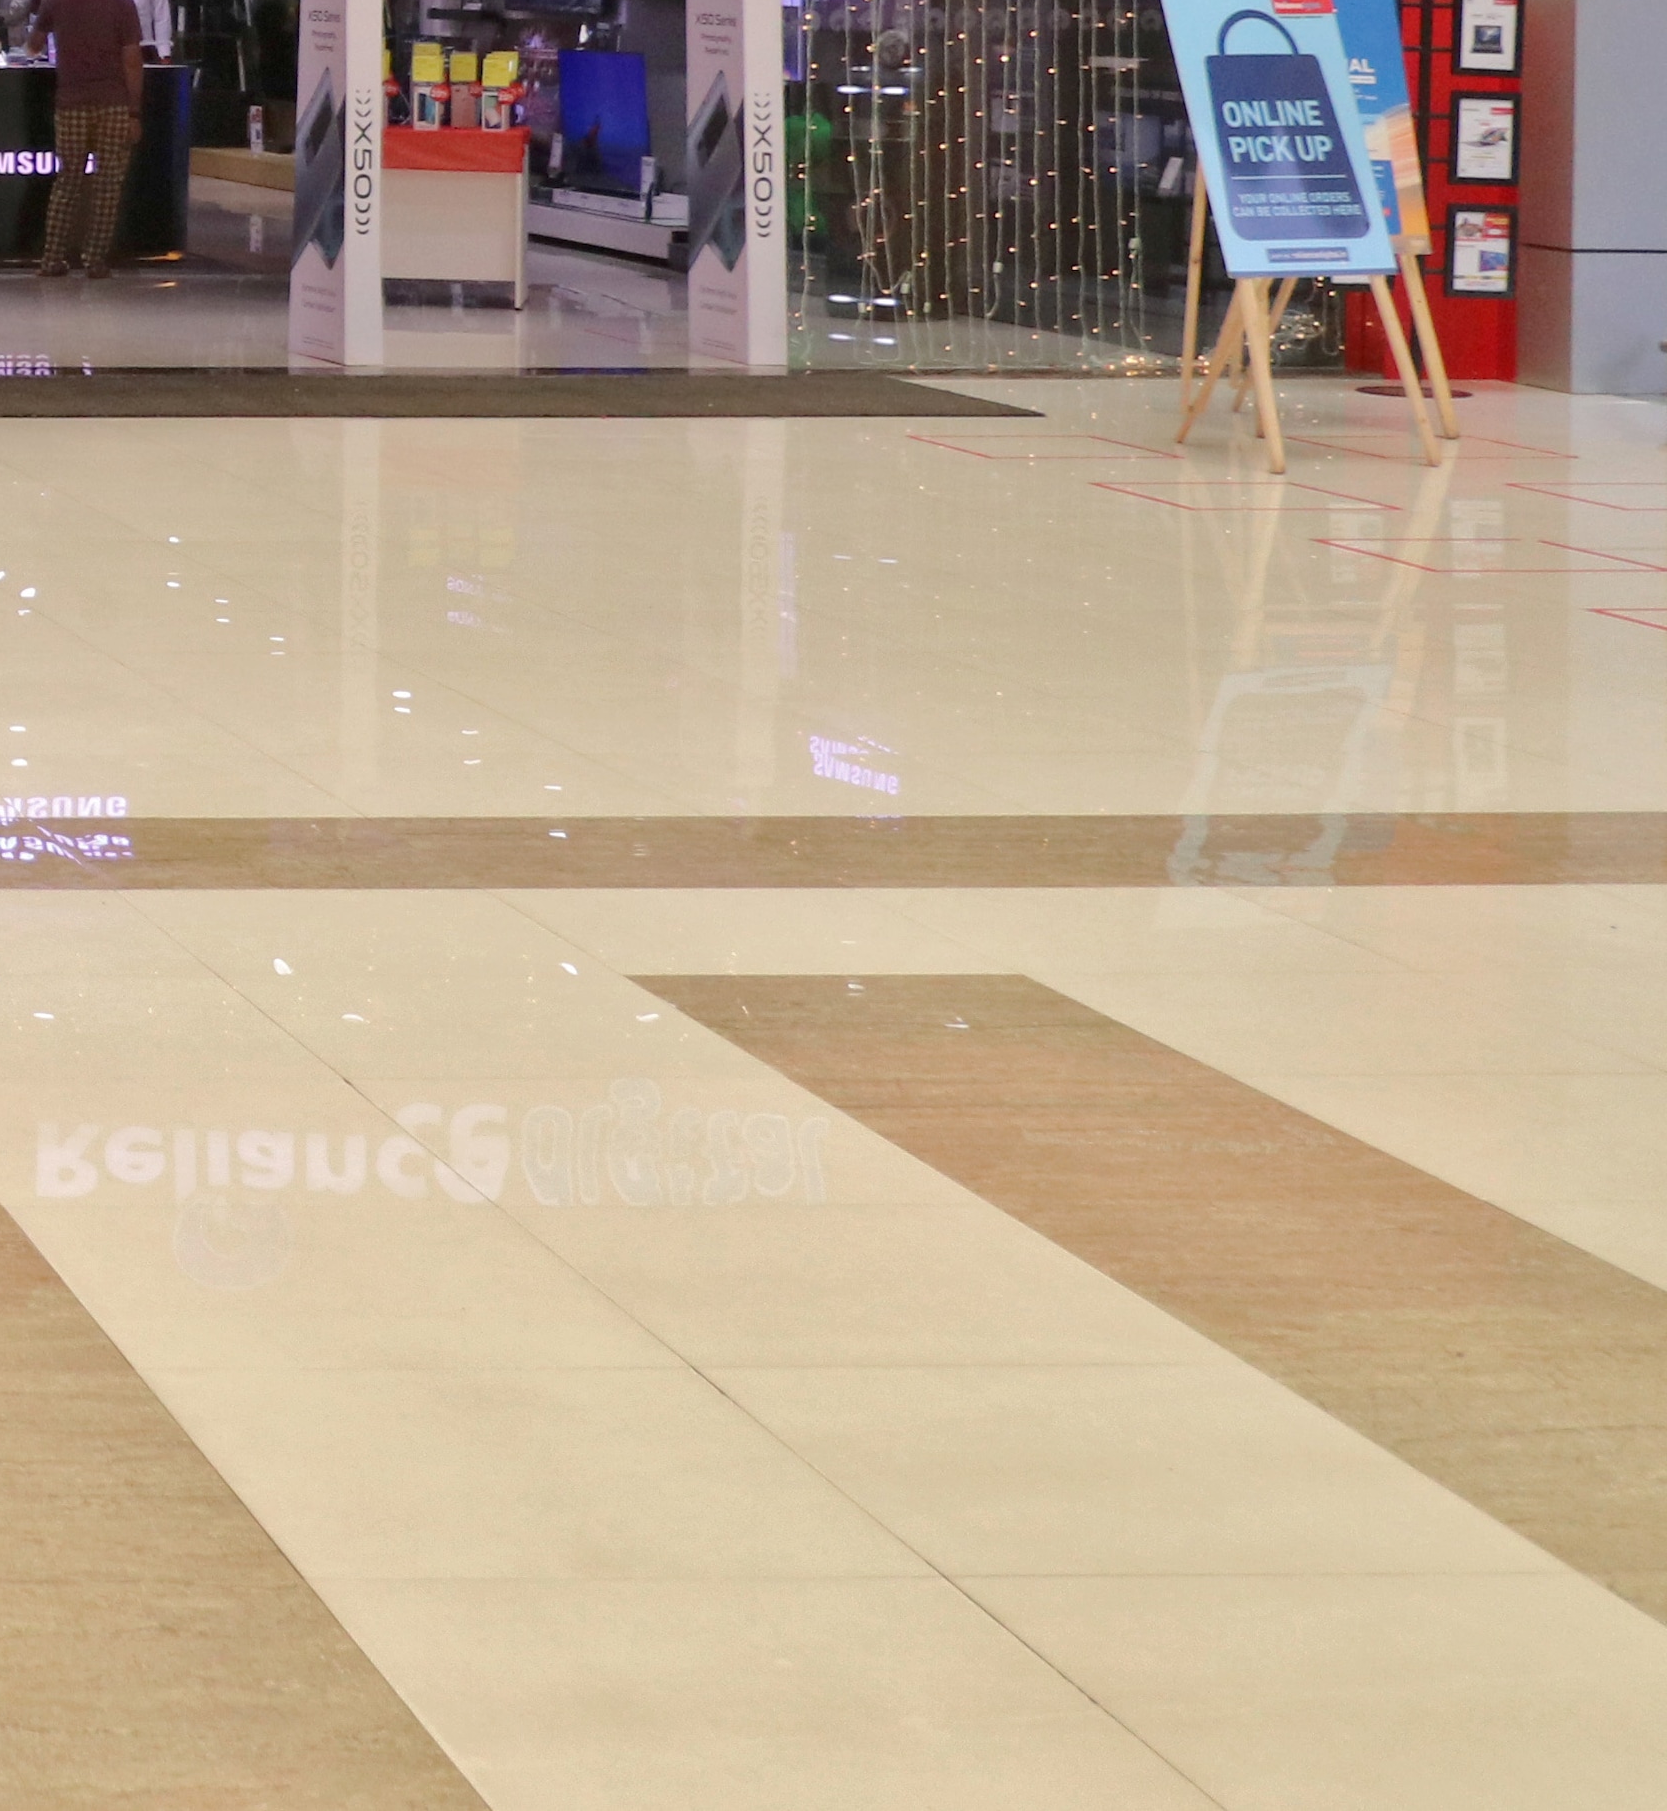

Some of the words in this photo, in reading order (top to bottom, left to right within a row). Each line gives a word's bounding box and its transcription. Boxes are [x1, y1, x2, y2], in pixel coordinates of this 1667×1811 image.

[1222, 100, 1323, 127] ONLINE
[352, 119, 374, 200] X50
[1228, 136, 1293, 163] PICK
[1297, 135, 1333, 162] UP
[752, 127, 774, 202] X50
[1232, 206, 1254, 217] CAN
[1273, 205, 1331, 216] COLLECTED
[1238, 193, 1267, 204] YOUR
[1269, 193, 1306, 204] ONLINE
